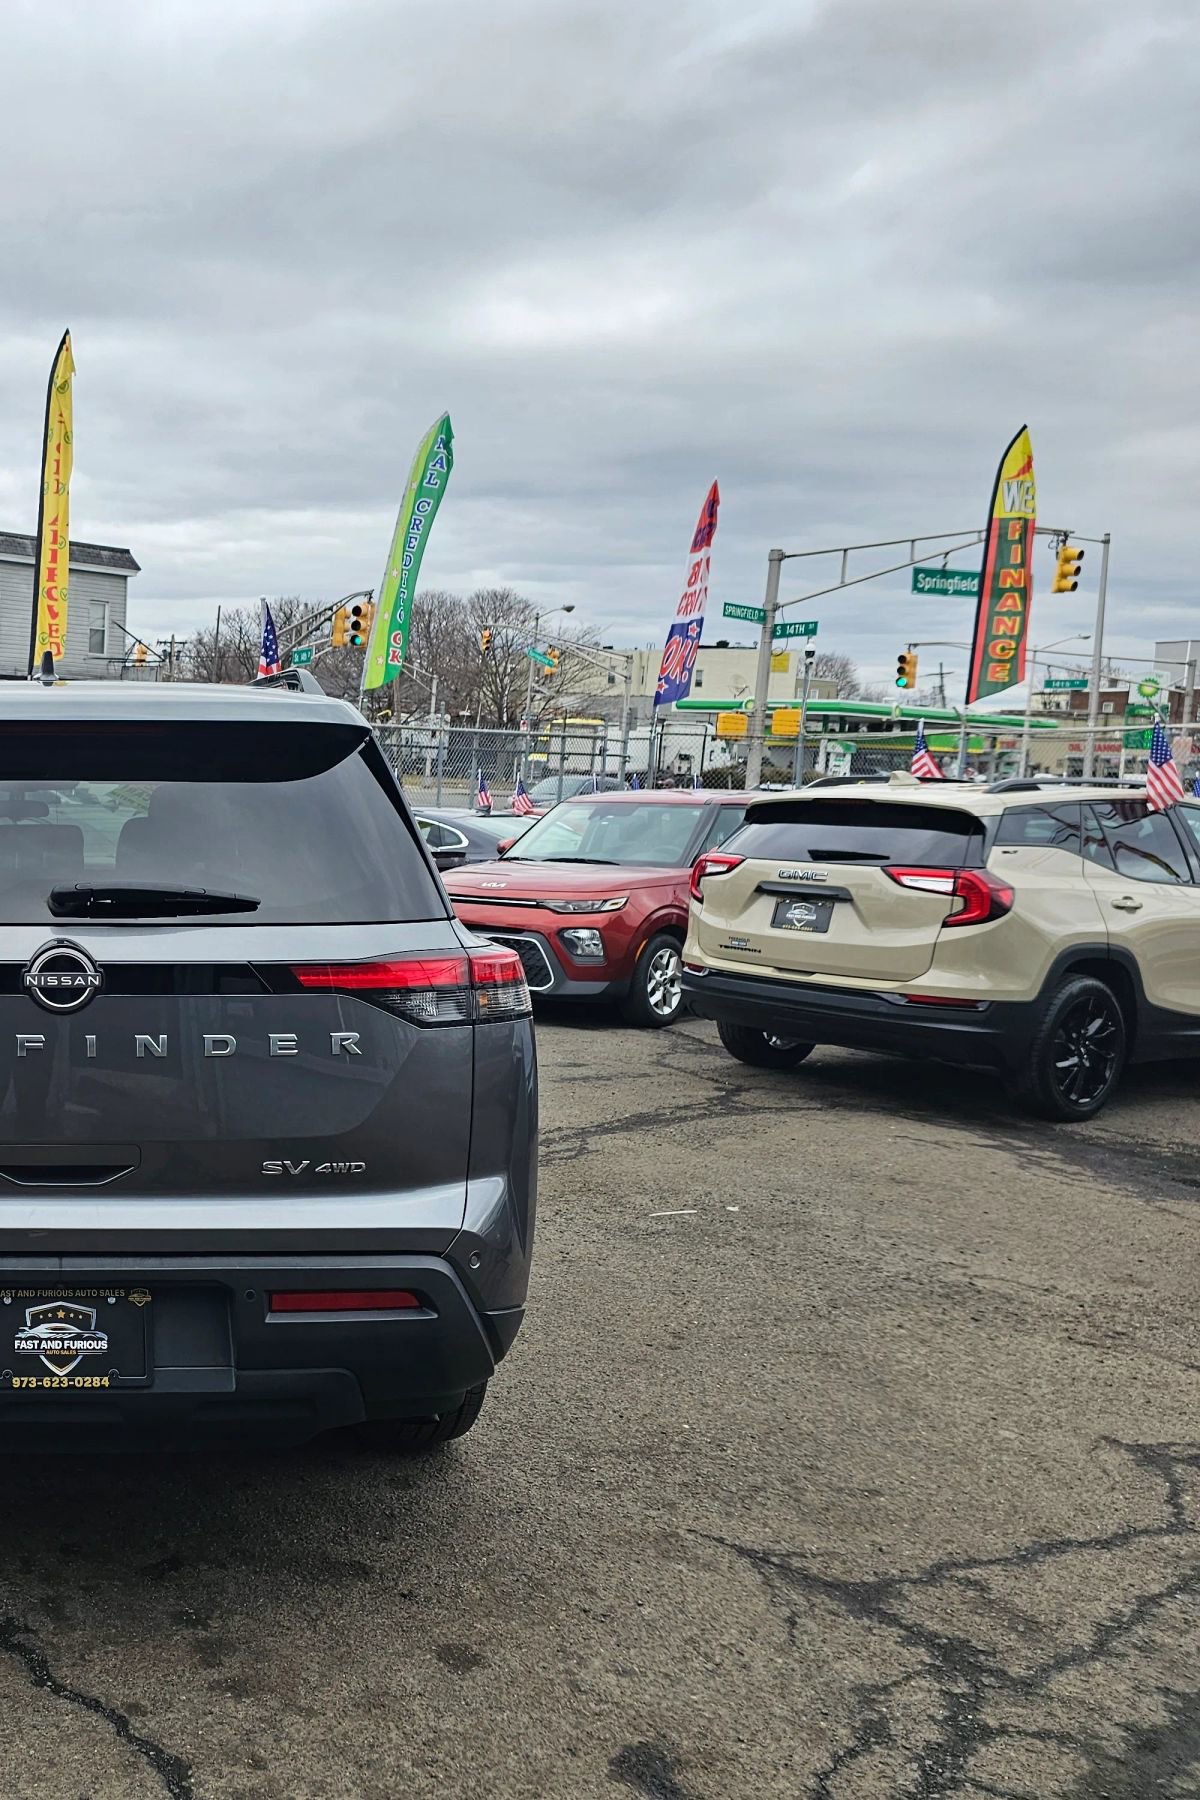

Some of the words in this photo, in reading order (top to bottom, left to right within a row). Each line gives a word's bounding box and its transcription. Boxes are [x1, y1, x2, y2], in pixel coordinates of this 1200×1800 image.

[1001, 480, 1035, 513] WE
[916, 572, 978, 592] Springfield
[986, 520, 1025, 683] FINANCE
[724, 605, 759, 620] SPRINGFIELD
[776, 626, 782, 635] S
[786, 624, 805, 635] 14TH
[778, 869, 829, 882] GMC
[26, 974, 100, 986] NISSAN
[260, 1160, 310, 1176] SV
[314, 1161, 367, 1175] 4WD
[17, 1289, 36, 1297] AND
[37, 1289, 73, 1297] FURIOUS
[75, 1289, 98, 1297] AUTO
[99, 1289, 125, 1297] SALES
[14, 1340, 40, 1350] FAST
[40, 1340, 62, 1350] AND
[64, 1340, 108, 1350] FURIOUS
[12, 1376, 110, 1388] 973-623-0284
